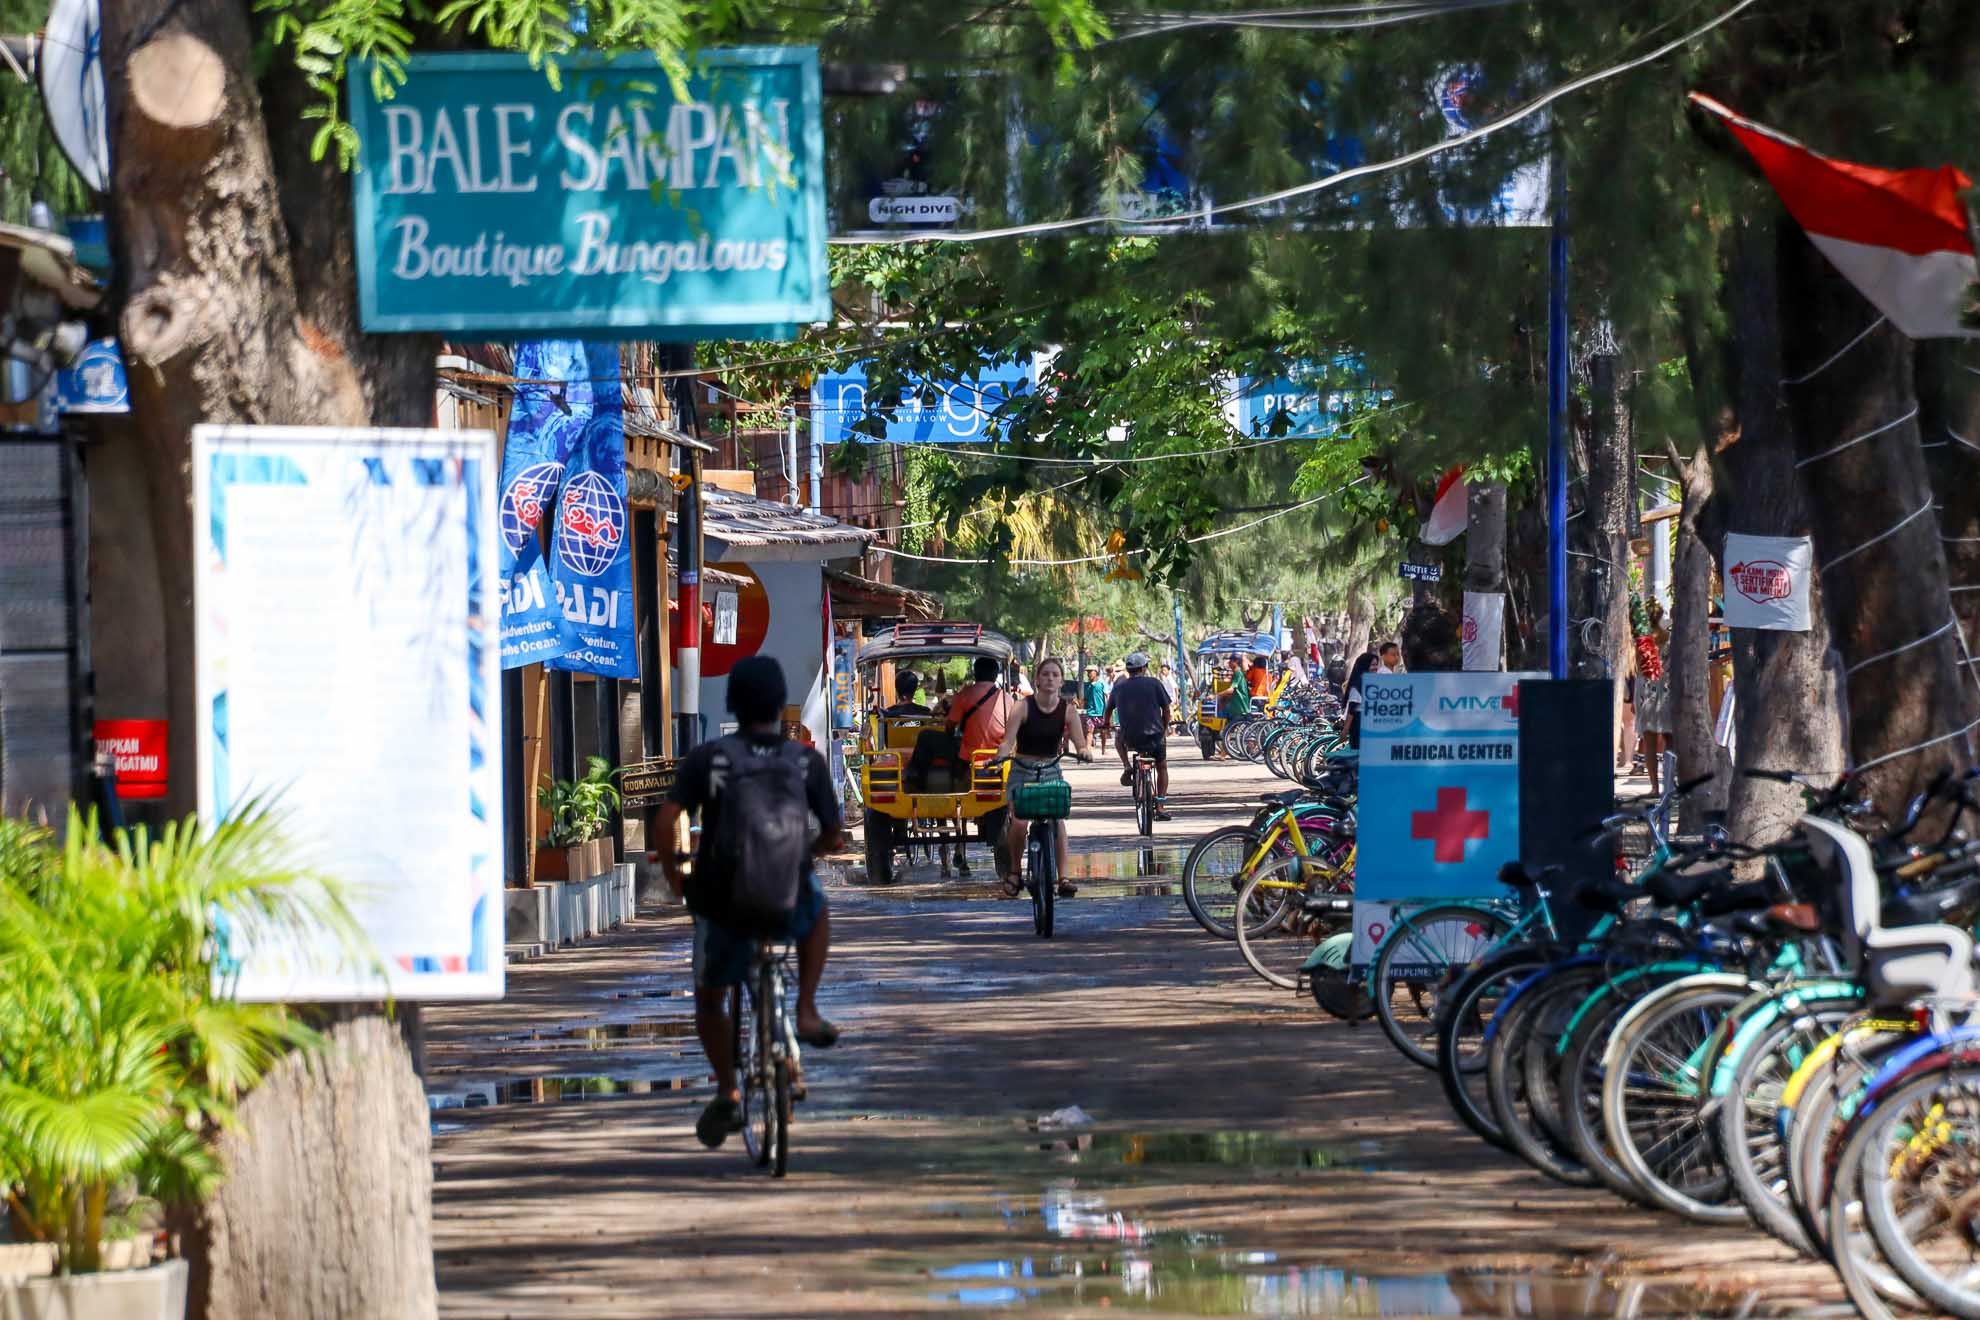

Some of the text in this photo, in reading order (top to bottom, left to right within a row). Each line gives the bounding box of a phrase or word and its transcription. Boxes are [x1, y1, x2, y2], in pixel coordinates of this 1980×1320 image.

[383, 99, 797, 194] BALE SAMPAN
[919, 204, 953, 214] DIVE
[393, 211, 788, 288] Boutique Bungalows
[838, 414, 865, 423] DIV
[836, 672, 850, 714] DIVE
[1365, 685, 1413, 700] Good
[1364, 701, 1413, 716] Heart
[1391, 744, 1513, 761] MEDICAL CENTER
